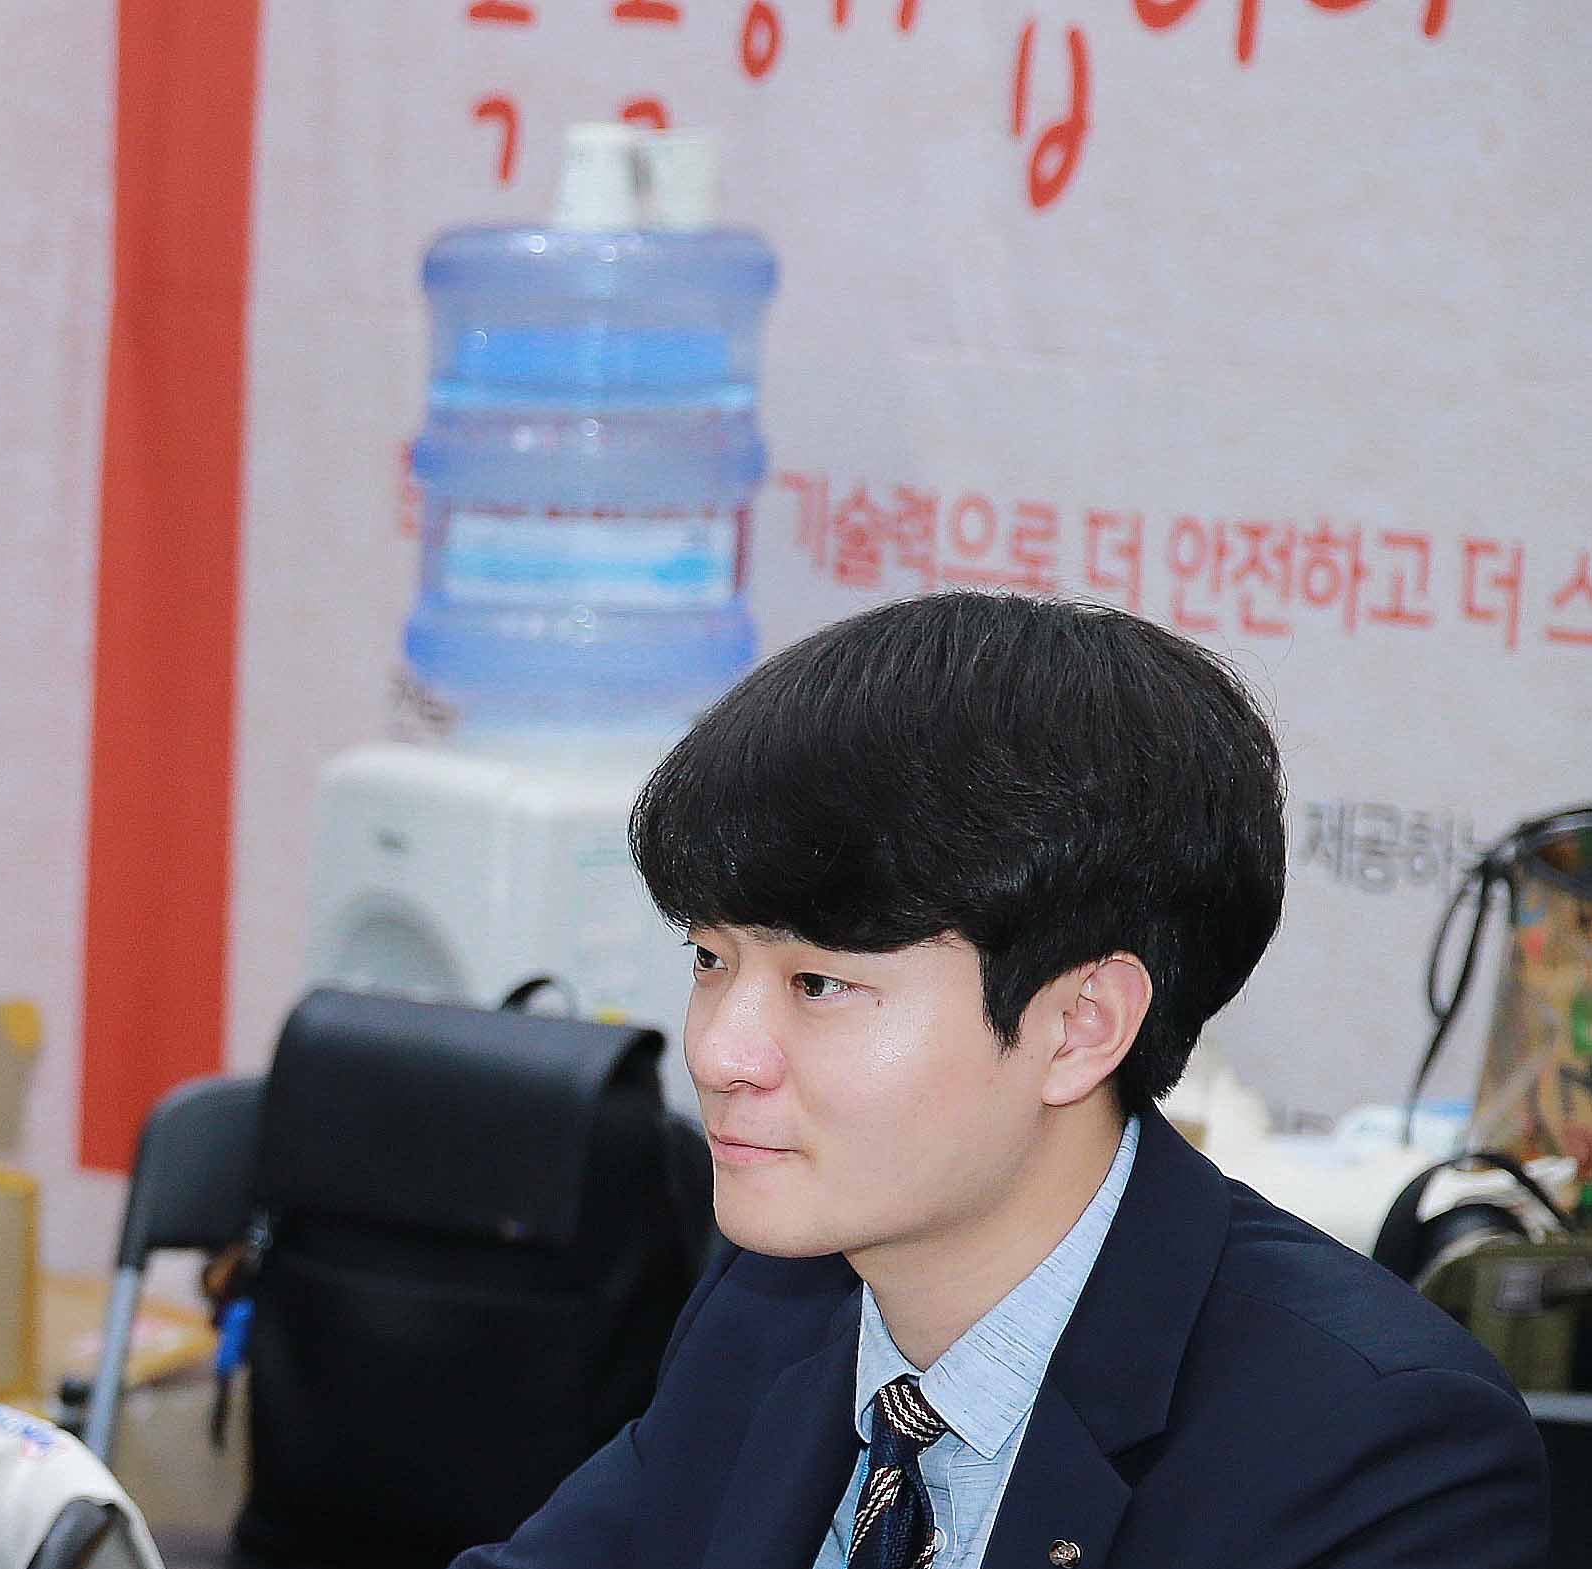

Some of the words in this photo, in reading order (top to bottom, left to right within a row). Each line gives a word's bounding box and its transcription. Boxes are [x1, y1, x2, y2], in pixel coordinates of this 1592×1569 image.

[779, 472, 1059, 593] 기술력으로
[1084, 508, 1145, 614] 더
[1166, 514, 1435, 636] 안전하고
[1461, 537, 1523, 650] 더
[1299, 802, 1480, 893] 제공하
